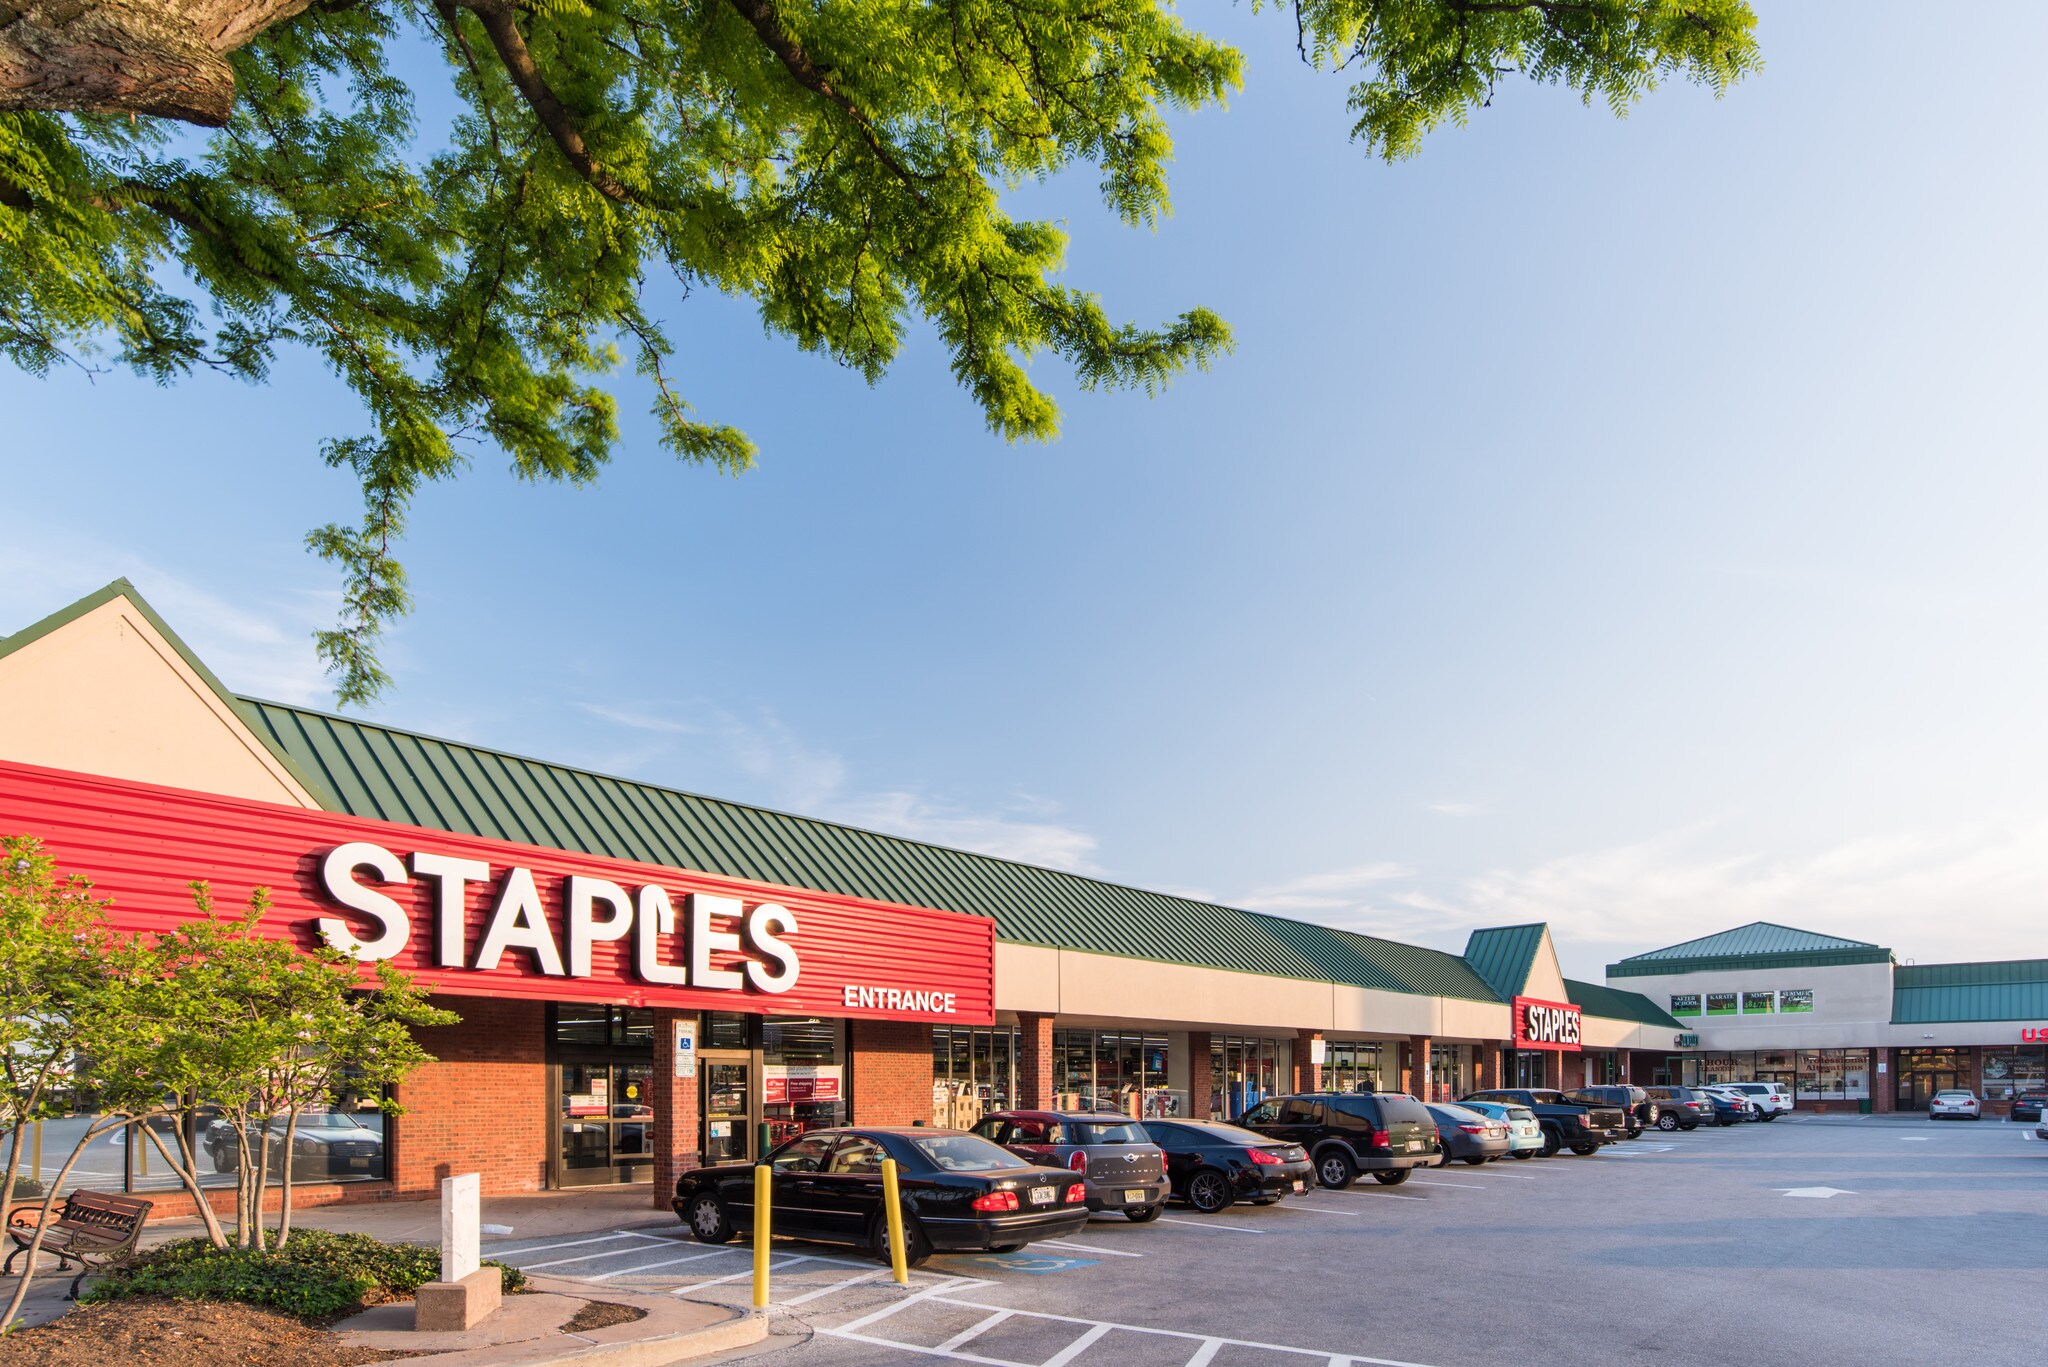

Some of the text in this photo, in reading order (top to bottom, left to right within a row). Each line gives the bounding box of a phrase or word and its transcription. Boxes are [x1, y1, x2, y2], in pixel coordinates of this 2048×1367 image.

[319, 842, 800, 994] STAPLES
[844, 985, 956, 1013] ENTRANCE
[1529, 1005, 1580, 1044] STAPLES
[1803, 1056, 1867, 1064] Professional
